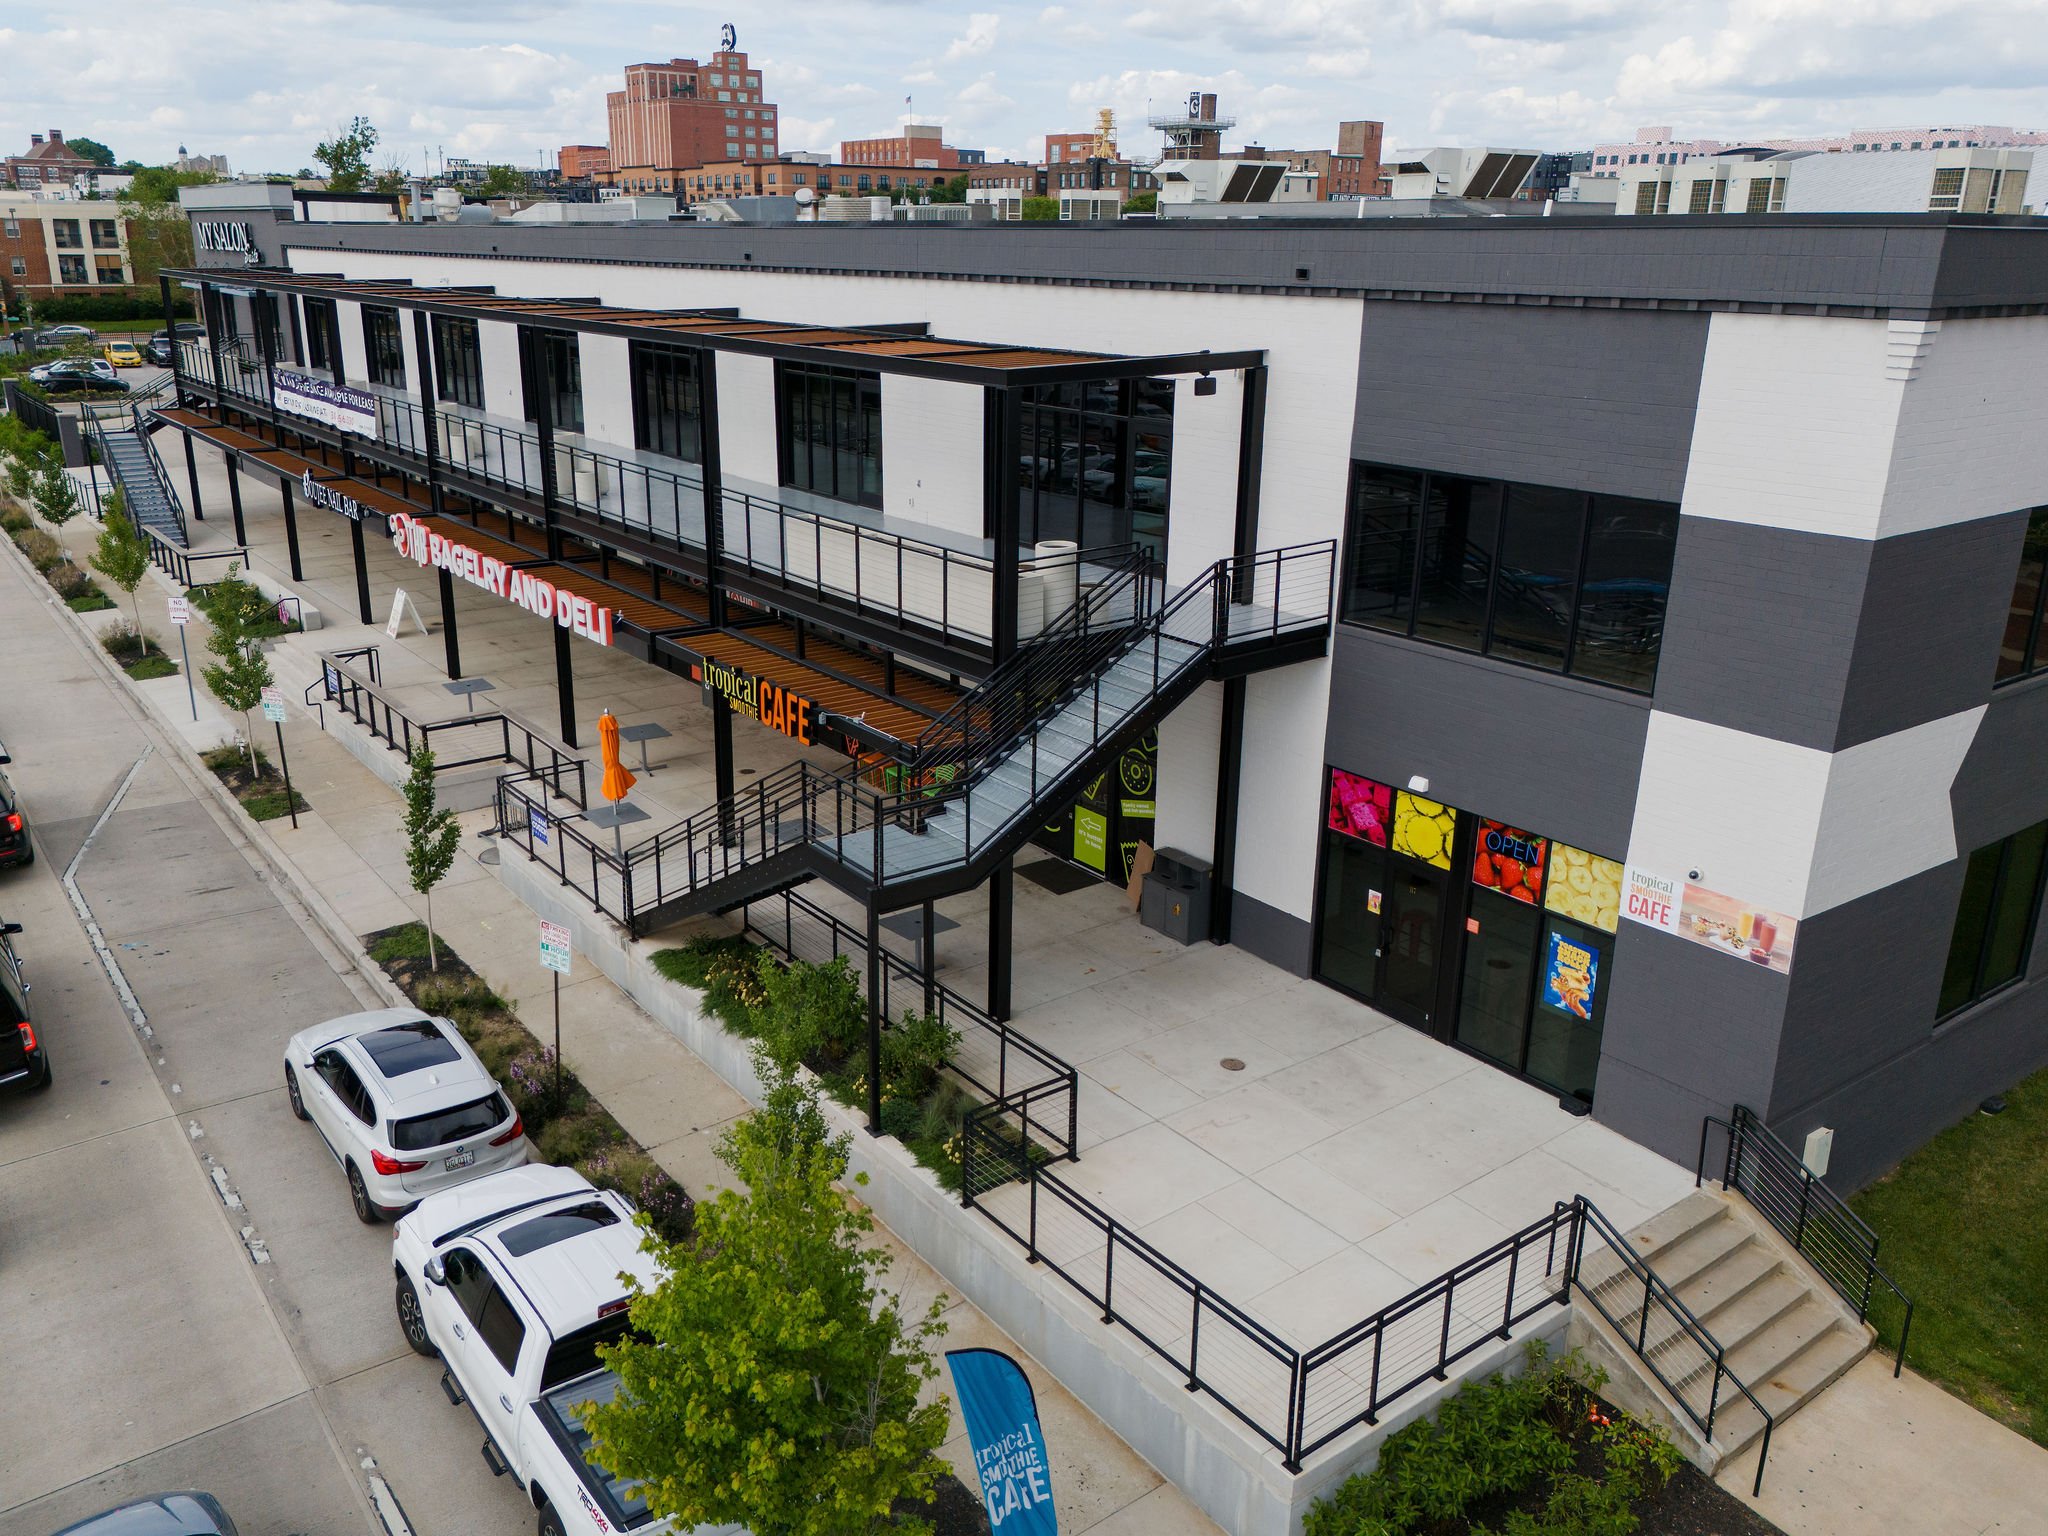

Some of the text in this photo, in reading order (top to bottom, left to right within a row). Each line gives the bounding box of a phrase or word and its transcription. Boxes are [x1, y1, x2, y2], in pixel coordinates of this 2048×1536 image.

[197, 222, 248, 252] MY SALON
[358, 396, 375, 411] LEASE
[303, 473, 359, 521] BOUJEE NAIL BAR
[429, 533, 512, 598] BAGELRY
[509, 569, 556, 619] AND
[556, 589, 612, 647] DELI
[703, 657, 758, 706] tropical
[729, 696, 759, 720] SMOOTHIE
[760, 681, 811, 747] CAFE
[1487, 831, 1540, 865] OPEN
[1630, 883, 1672, 905] SMOOTHIE
[1631, 870, 1673, 893] tropical
[1628, 894, 1671, 926] CAFE
[976, 1423, 1035, 1469] tropical
[982, 1447, 1040, 1490] SMOOTHIE
[577, 1484, 593, 1512] TRD
[987, 1466, 1050, 1526] CAFE
